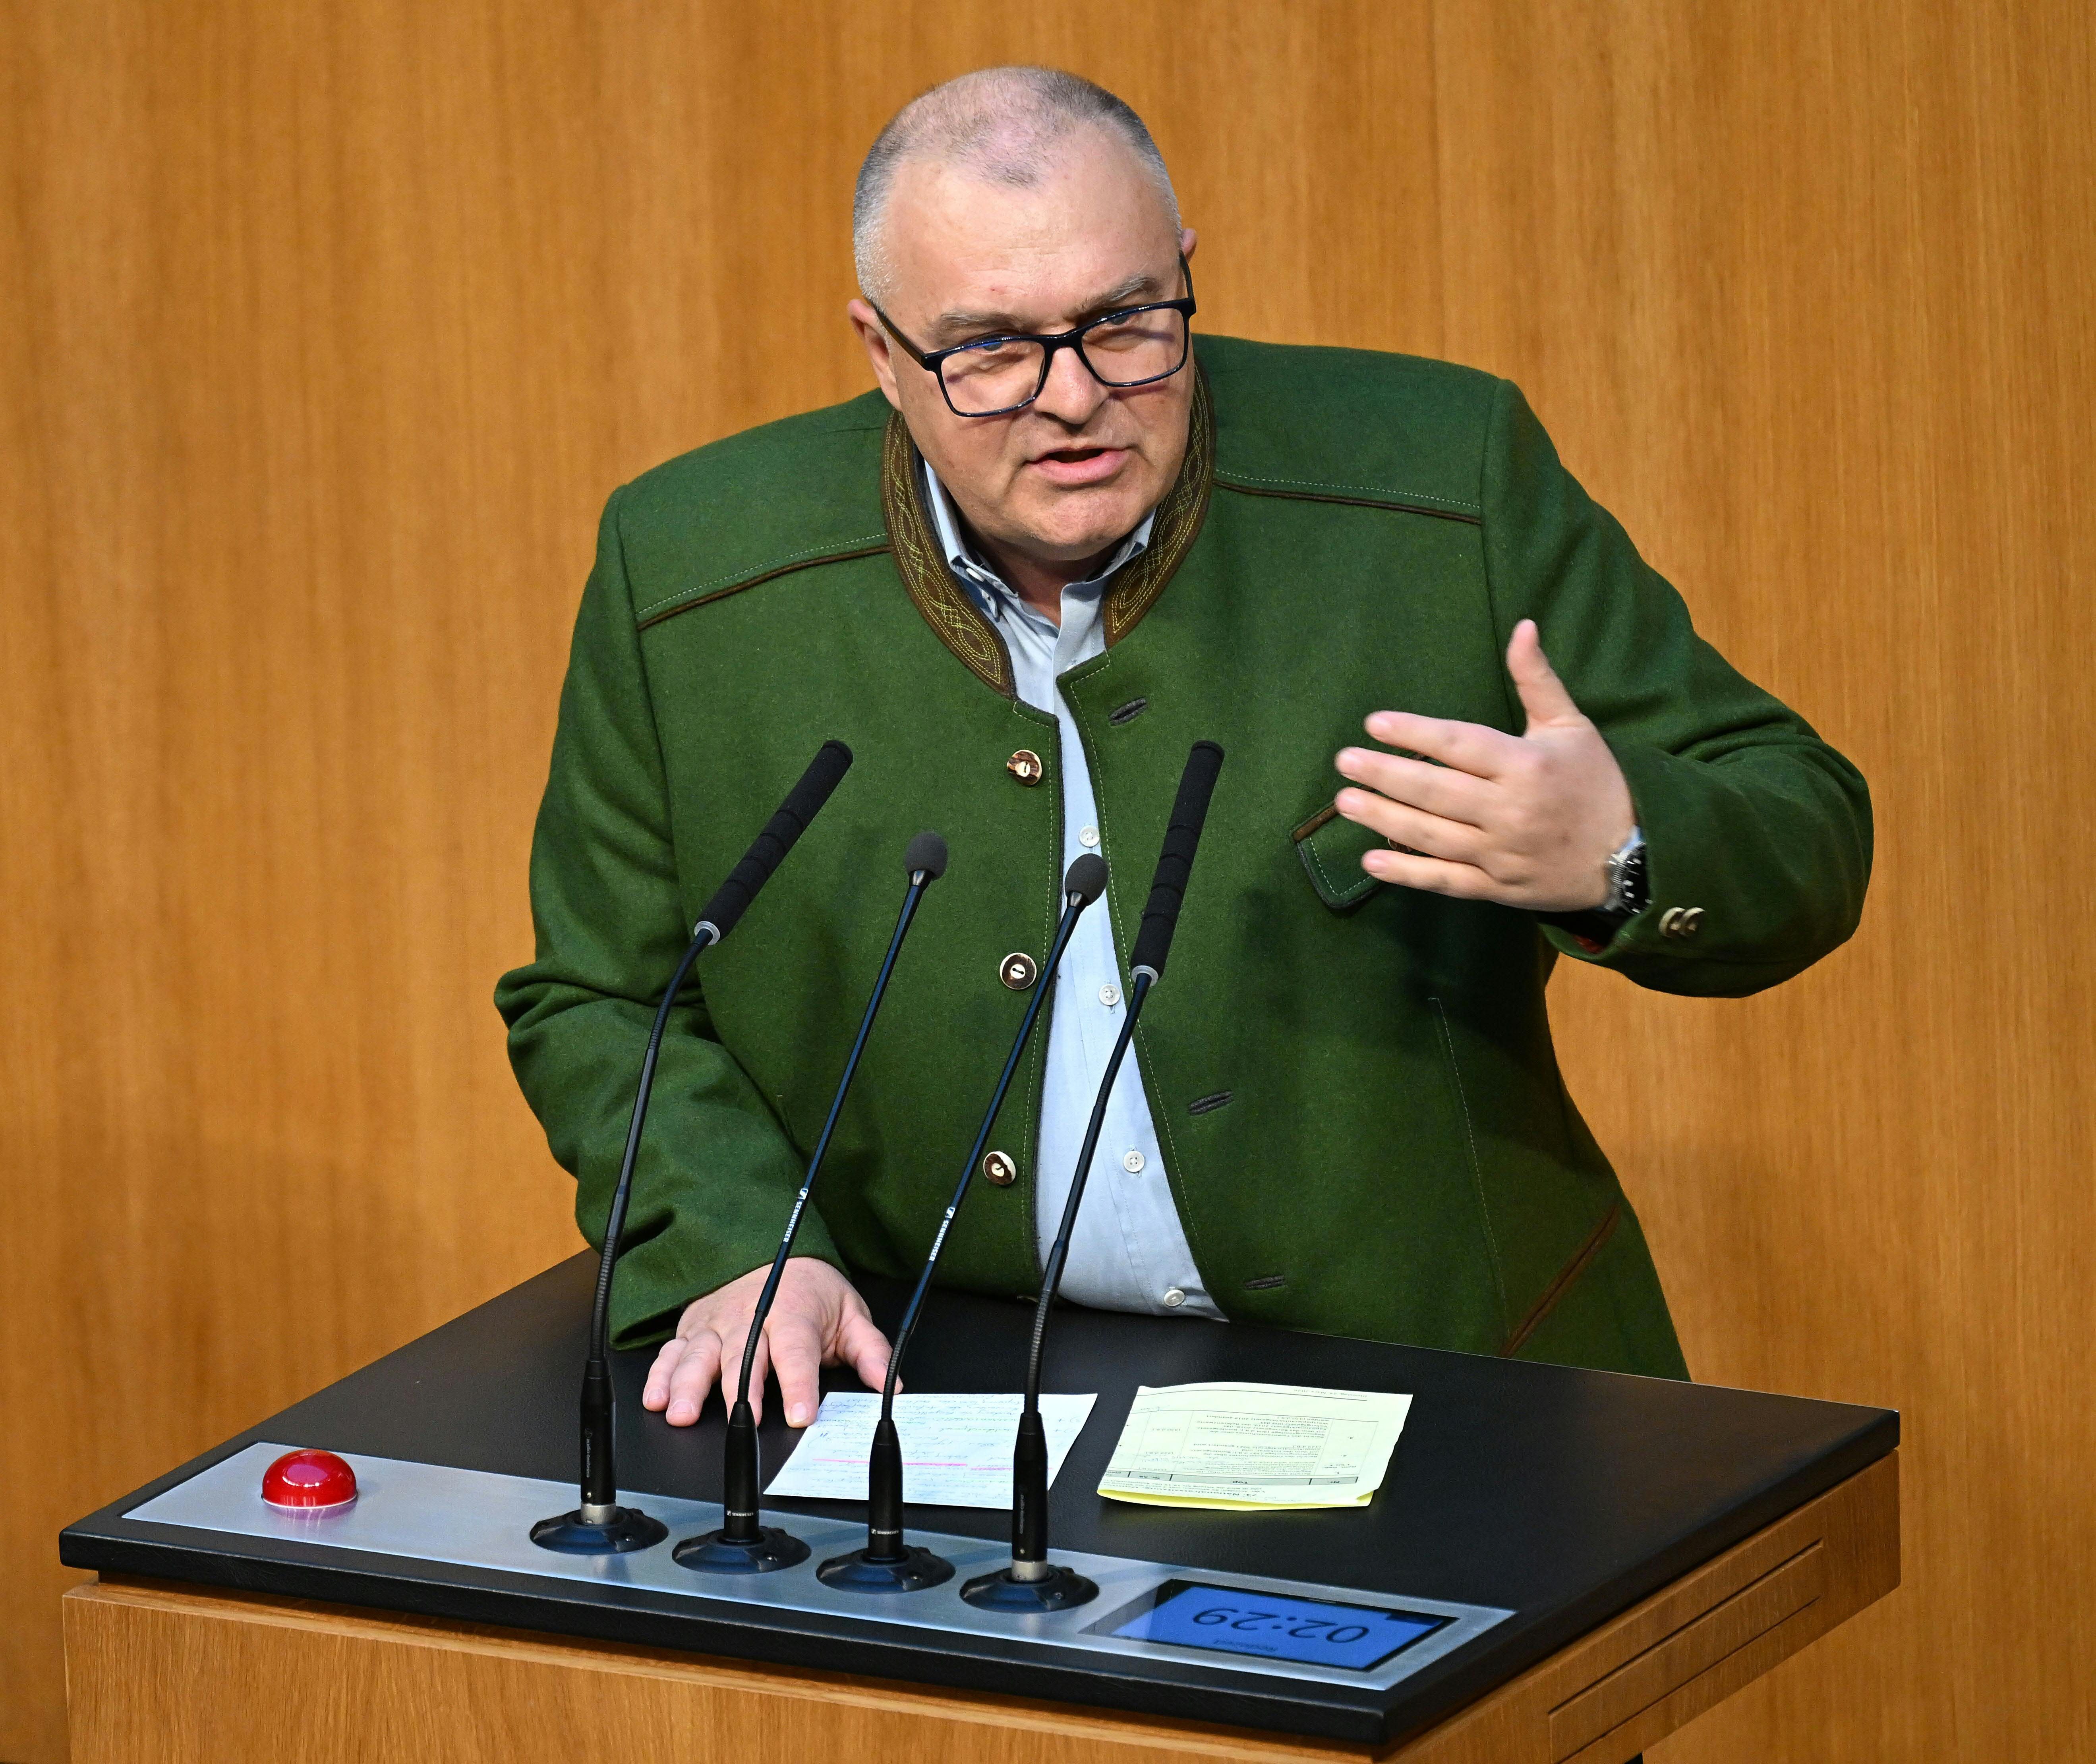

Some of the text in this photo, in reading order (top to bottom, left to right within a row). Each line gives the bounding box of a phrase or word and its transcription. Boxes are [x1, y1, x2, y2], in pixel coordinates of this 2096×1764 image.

[783, 1201, 802, 1242] SENNHEISER
[928, 1220, 949, 1261] SENNHEISER
[1193, 1608, 1369, 1643] 02:29
